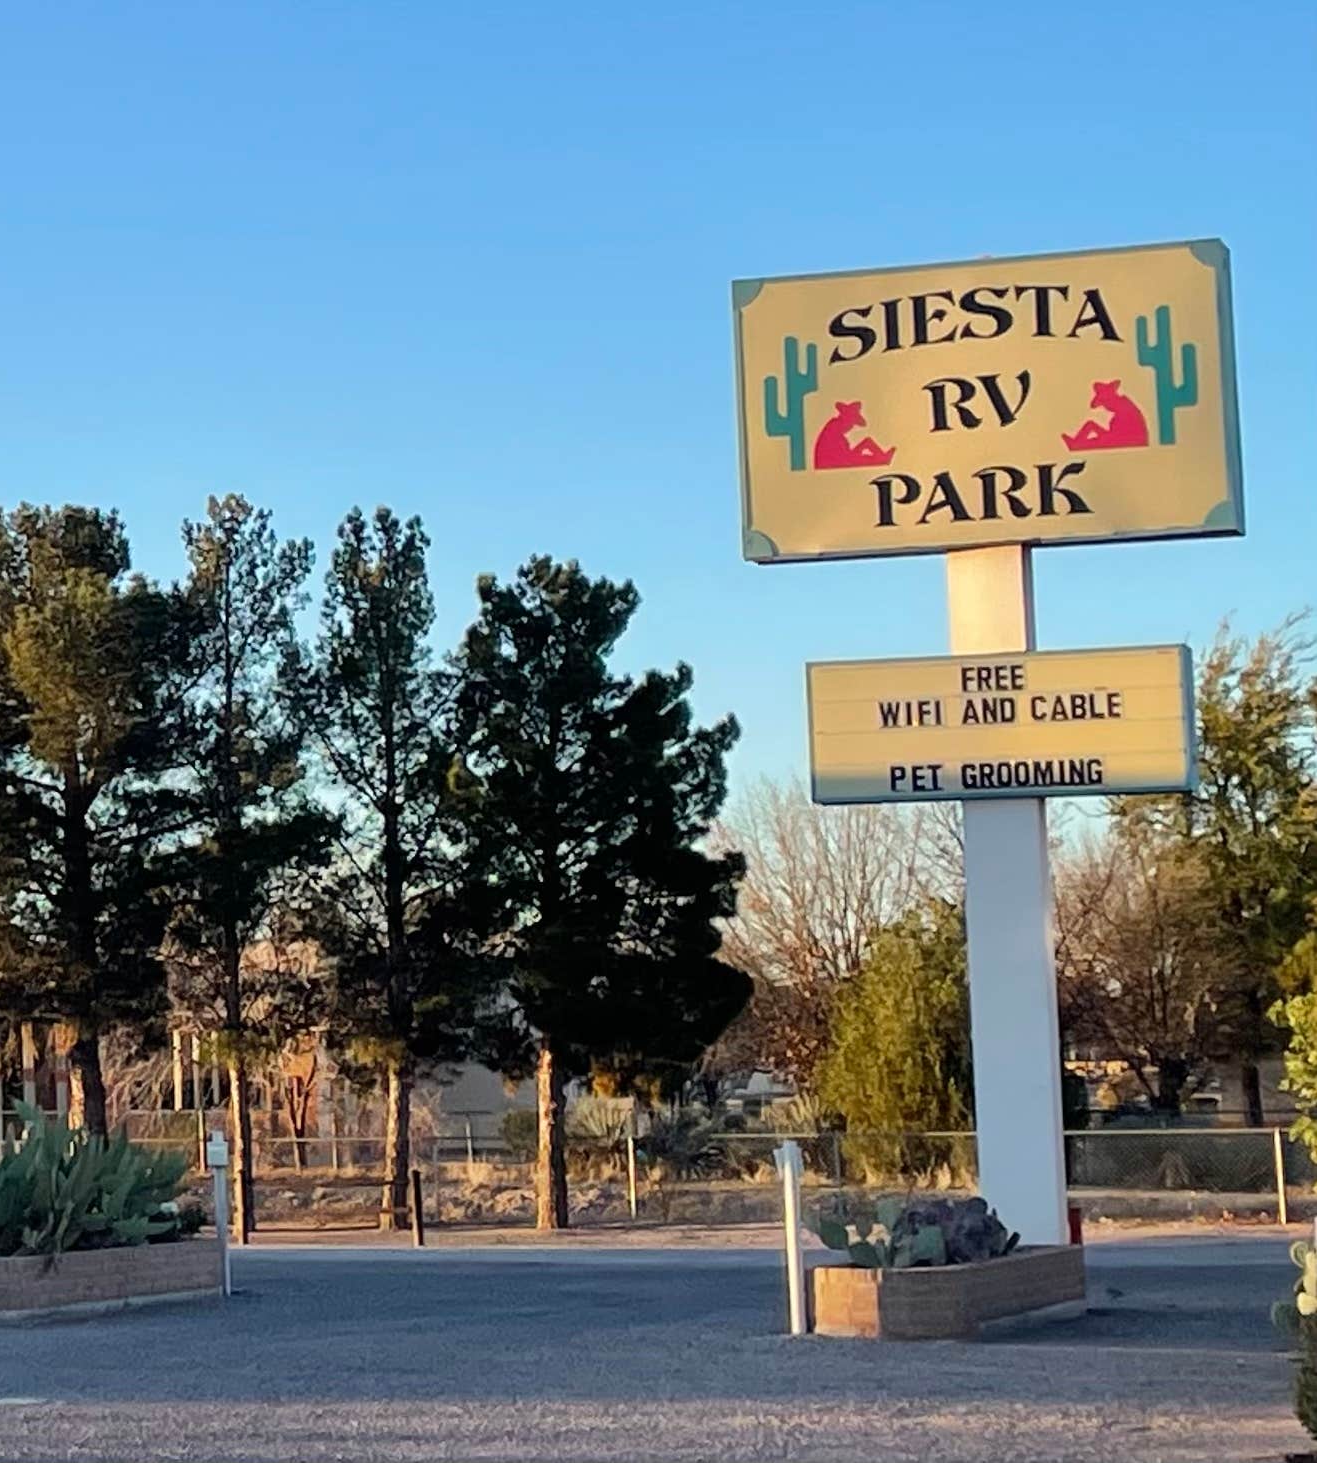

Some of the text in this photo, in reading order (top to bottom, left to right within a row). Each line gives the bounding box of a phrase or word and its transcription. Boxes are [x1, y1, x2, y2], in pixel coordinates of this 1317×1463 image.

[828, 285, 1124, 366] SIESTA
[922, 370, 1031, 433] RV
[869, 461, 1095, 528] PARK
[961, 665, 1024, 692] FREE
[879, 693, 1121, 728] WIFI AND CABLE
[890, 759, 1103, 792] PET GROOMING
